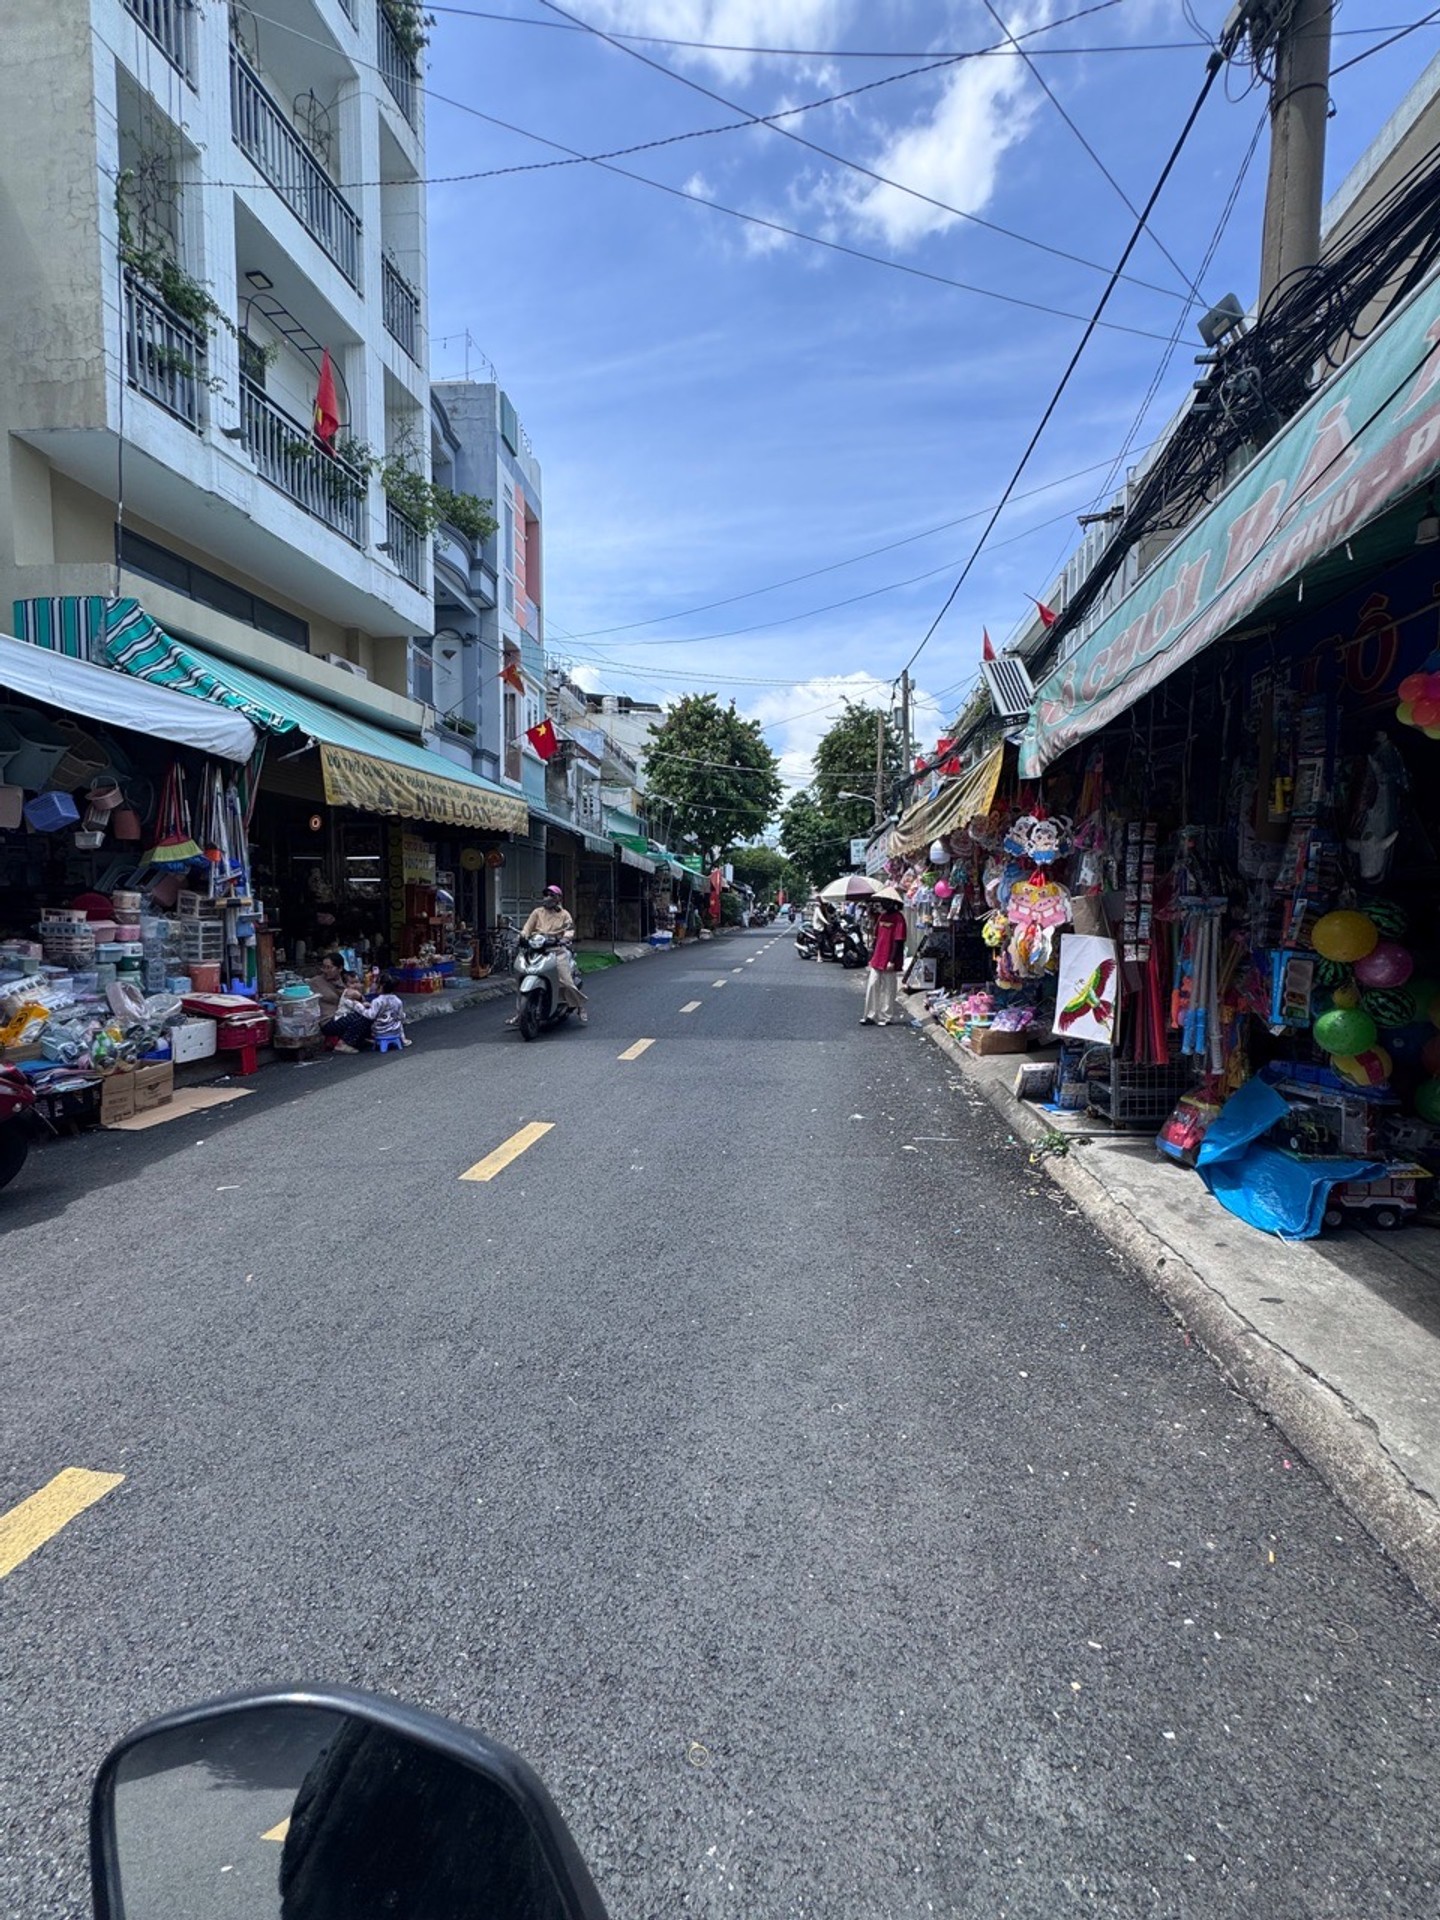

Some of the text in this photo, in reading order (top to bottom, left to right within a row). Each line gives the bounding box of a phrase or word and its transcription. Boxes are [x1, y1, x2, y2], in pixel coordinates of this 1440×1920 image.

[1283, 478, 1360, 564] PHÚ
[1082, 548, 1211, 704] CHƠI
[451, 800, 492, 824] LOAN
